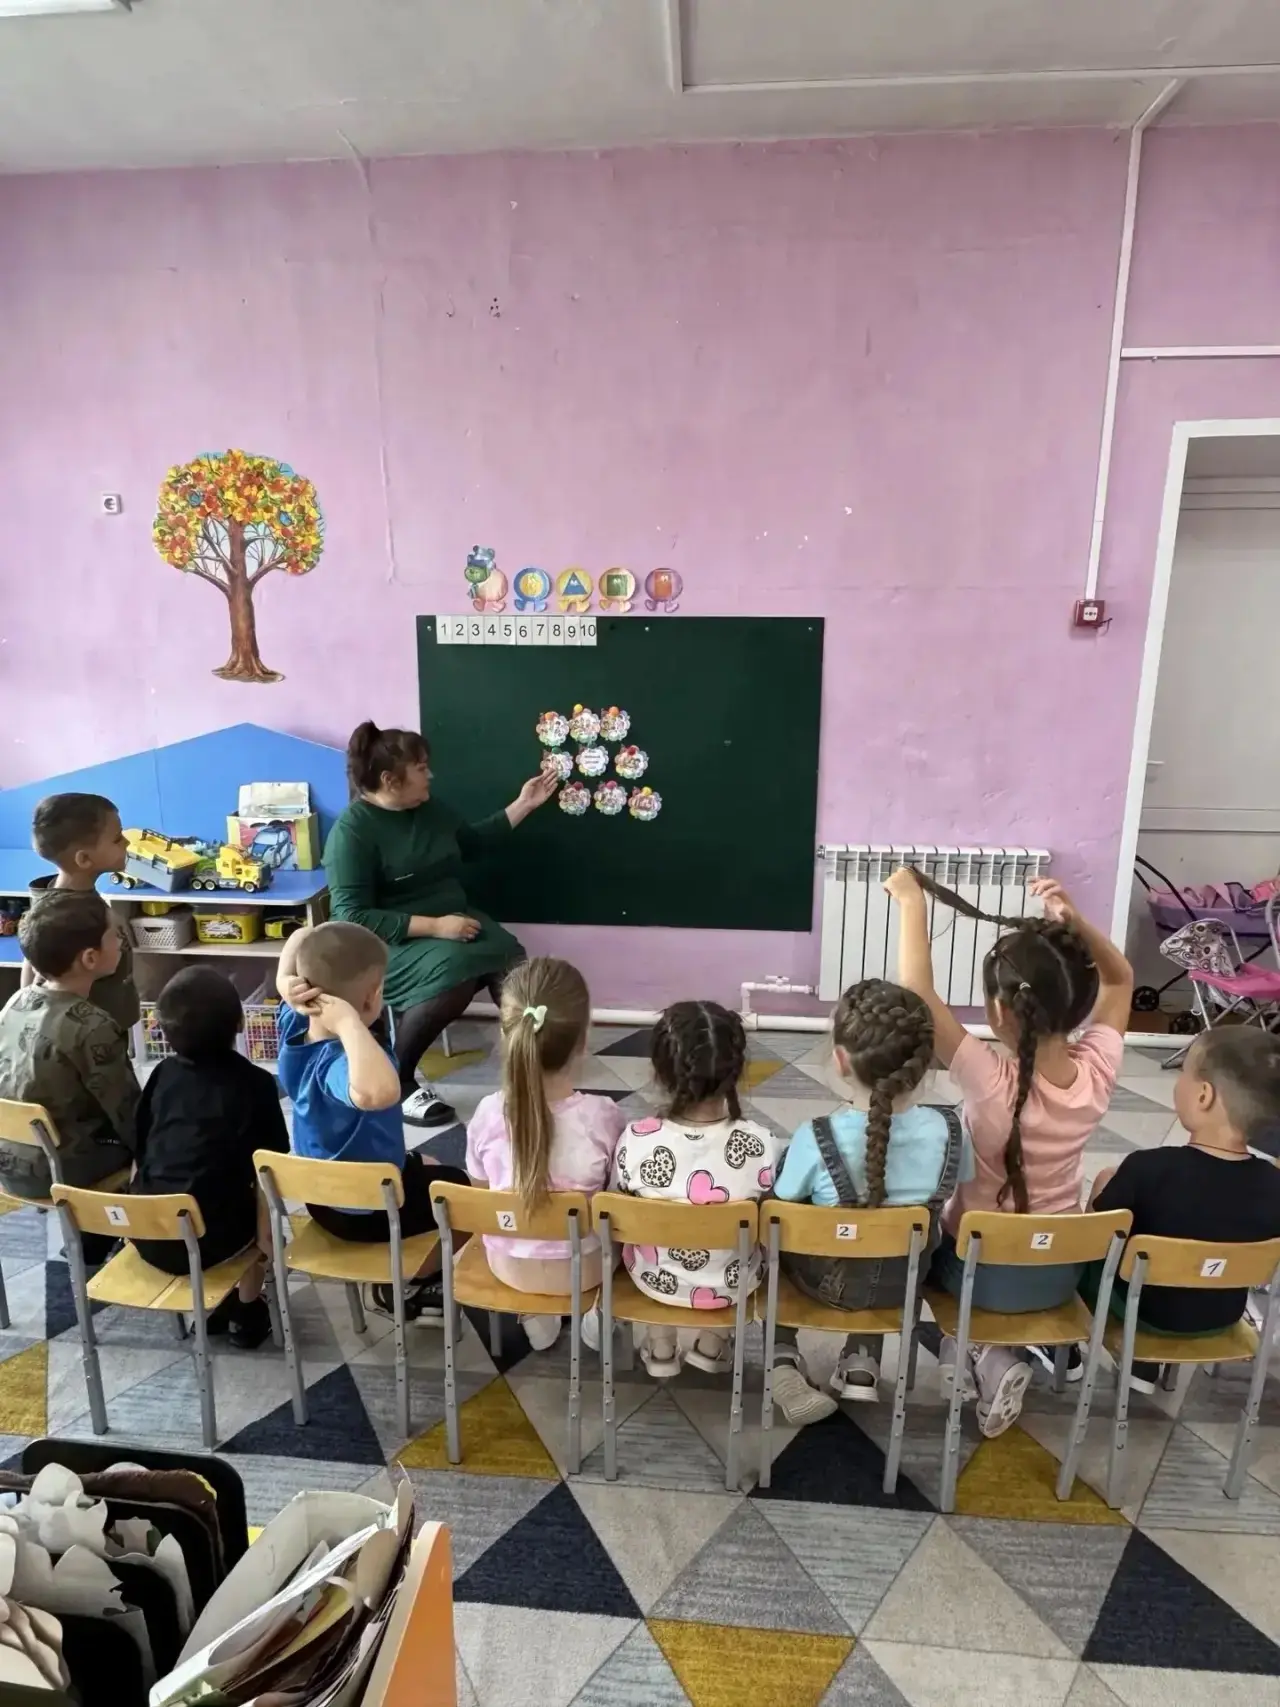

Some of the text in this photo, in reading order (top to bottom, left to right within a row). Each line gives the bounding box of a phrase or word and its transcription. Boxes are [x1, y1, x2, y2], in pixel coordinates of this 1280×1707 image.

[456, 624, 464, 636] 2
[472, 624, 480, 636] 3
[488, 624, 496, 636] 4
[504, 625, 512, 636] 5
[519, 626, 528, 637] 6
[537, 624, 545, 636] 7
[553, 625, 561, 637] 8
[567, 626, 576, 638] 9
[580, 625, 597, 637] 10
[111, 1211, 120, 1221] 1
[503, 1215, 513, 1228] 2
[839, 1226, 849, 1237] 2
[1038, 1234, 1048, 1246] 2
[1207, 1261, 1222, 1275] 1
